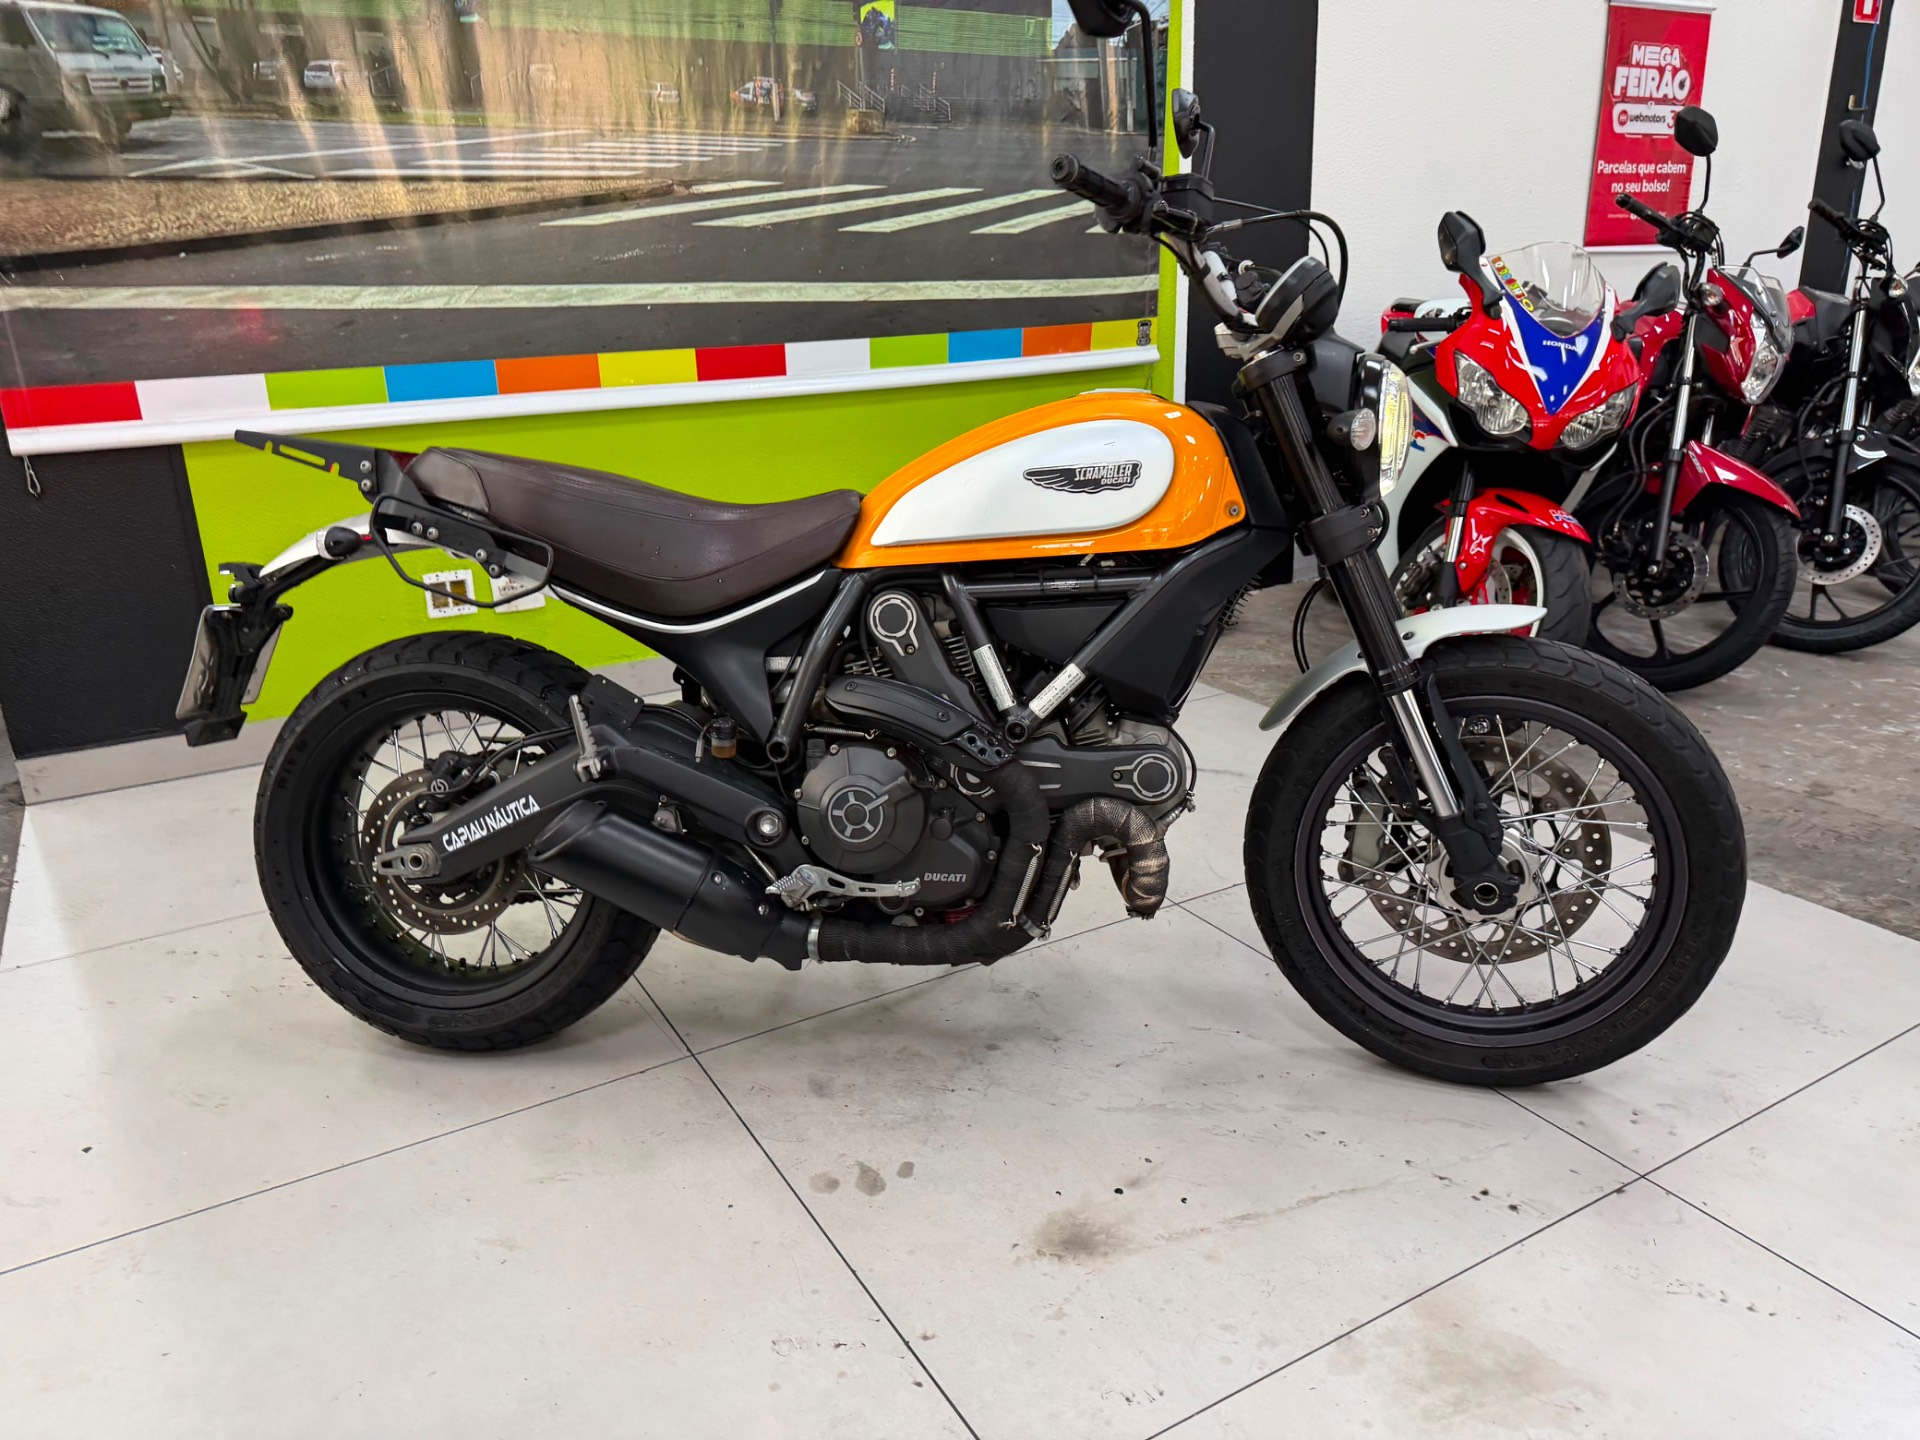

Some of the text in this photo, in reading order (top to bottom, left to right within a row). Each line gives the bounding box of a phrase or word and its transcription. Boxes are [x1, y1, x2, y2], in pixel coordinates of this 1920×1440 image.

[1631, 44, 1681, 68] MEGA
[1613, 65, 1691, 101] FEIRÃO
[1628, 112, 1667, 123] webmotors
[1597, 160, 1687, 177] Parcelas que cabem
[1611, 179, 1671, 193] no seu bolso!
[1542, 340, 1578, 351] HONDA
[1073, 464, 1133, 481] SCRAMBLER
[1101, 477, 1131, 485] DUCATI
[442, 794, 541, 852] CAPIAU NÁUTICA
[924, 872, 967, 882] DUCATI
